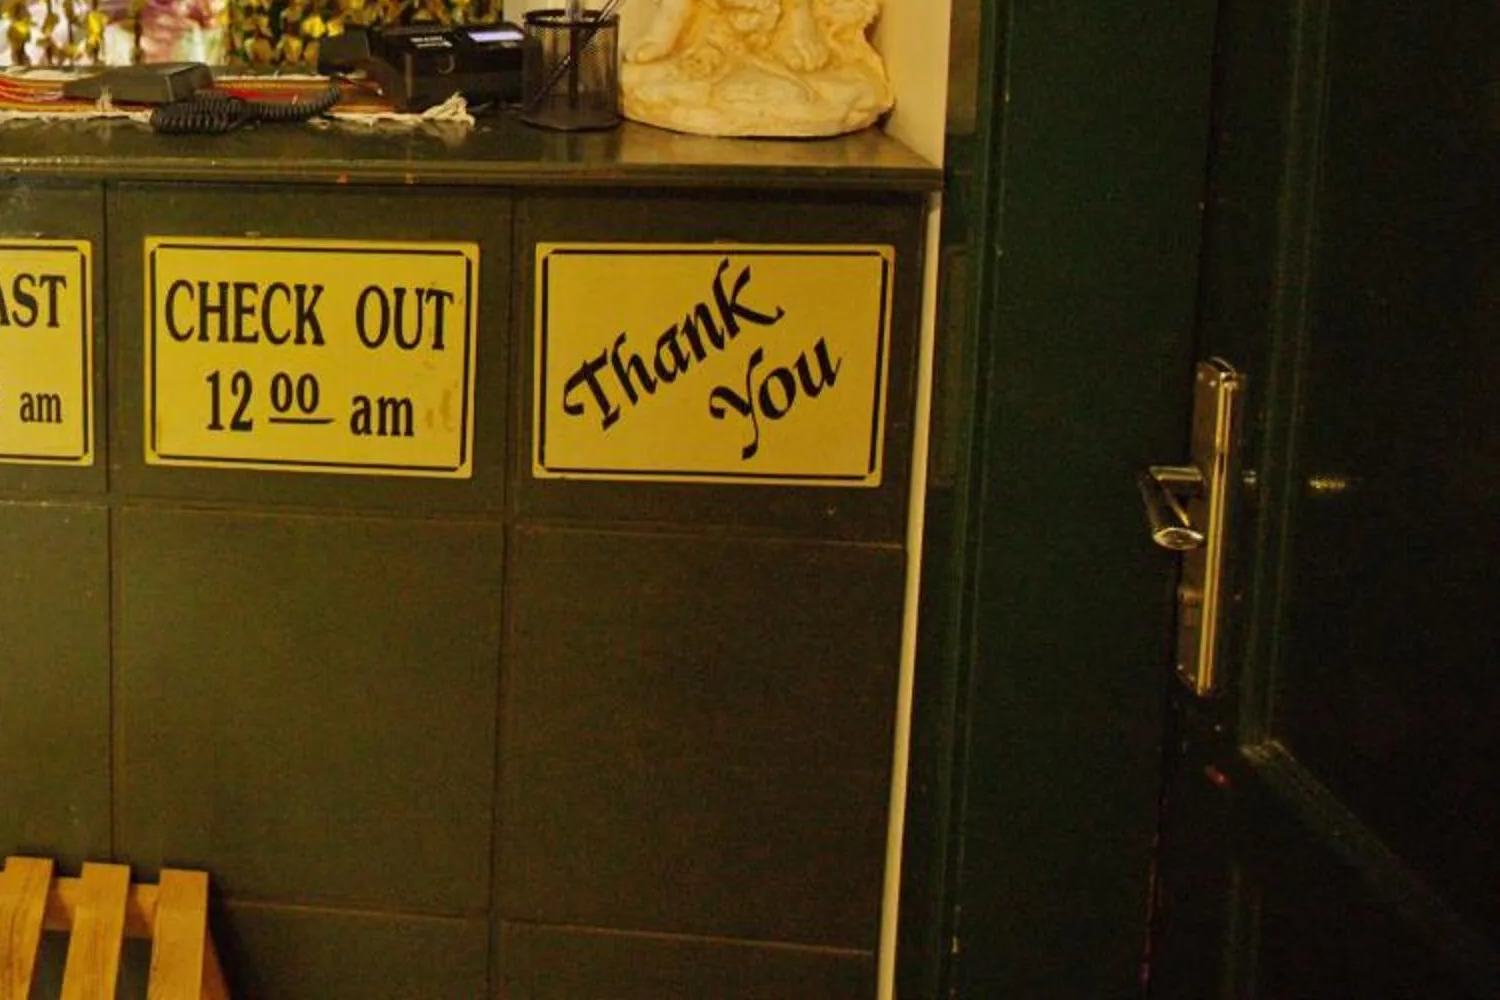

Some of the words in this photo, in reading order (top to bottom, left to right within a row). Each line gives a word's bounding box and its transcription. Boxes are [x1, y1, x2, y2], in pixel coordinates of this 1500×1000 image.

[166, 279, 326, 347] CHECK
[356, 285, 455, 350] OUT
[563, 257, 785, 430] Thank
[19, 391, 63, 424] am
[349, 396, 415, 437] am
[709, 336, 842, 460] You
